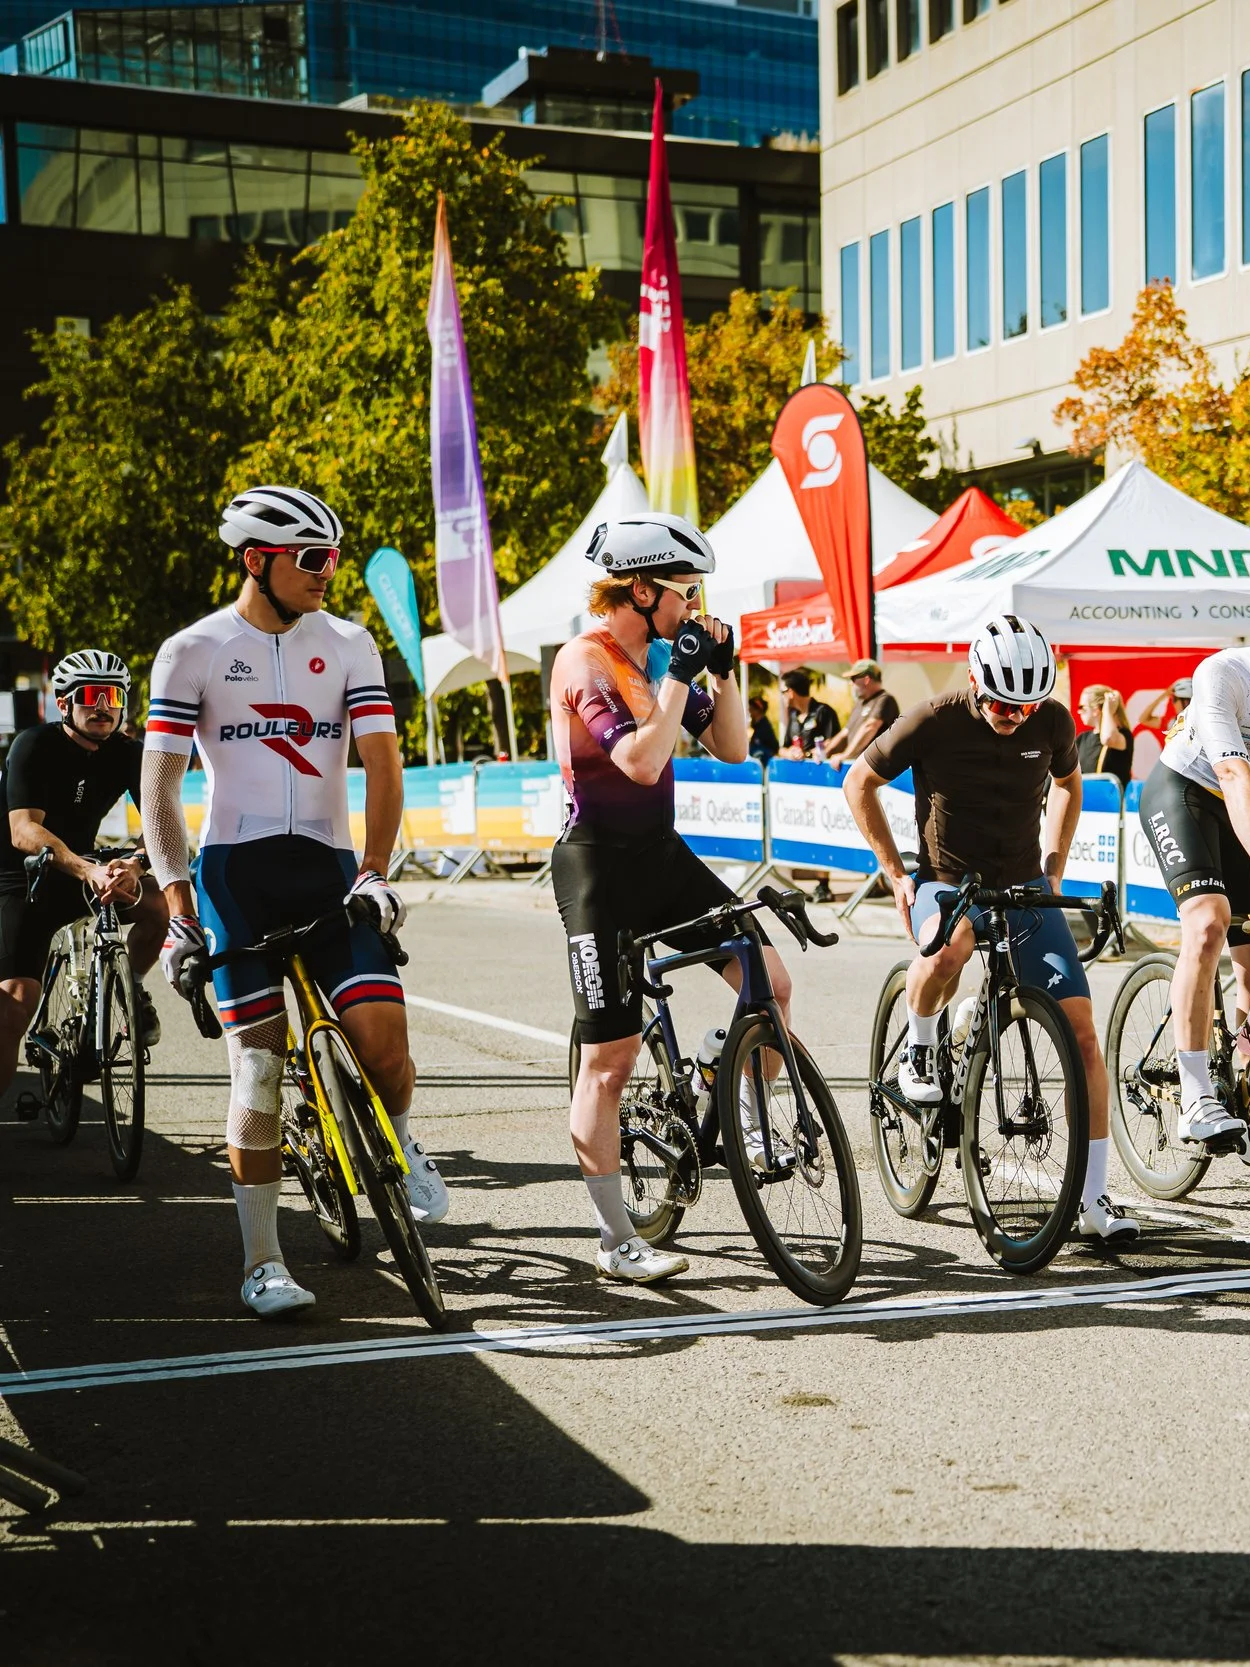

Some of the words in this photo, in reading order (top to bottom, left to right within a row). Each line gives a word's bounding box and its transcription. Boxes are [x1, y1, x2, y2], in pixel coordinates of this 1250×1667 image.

[615, 550, 675, 568] S-WORKS
[1070, 604, 1182, 620] ACCOUNTING
[220, 721, 342, 742] ROULEURS
[706, 800, 745, 823] Québec
[1151, 810, 1186, 866] LRCC
[571, 952, 583, 994] OBERSON
